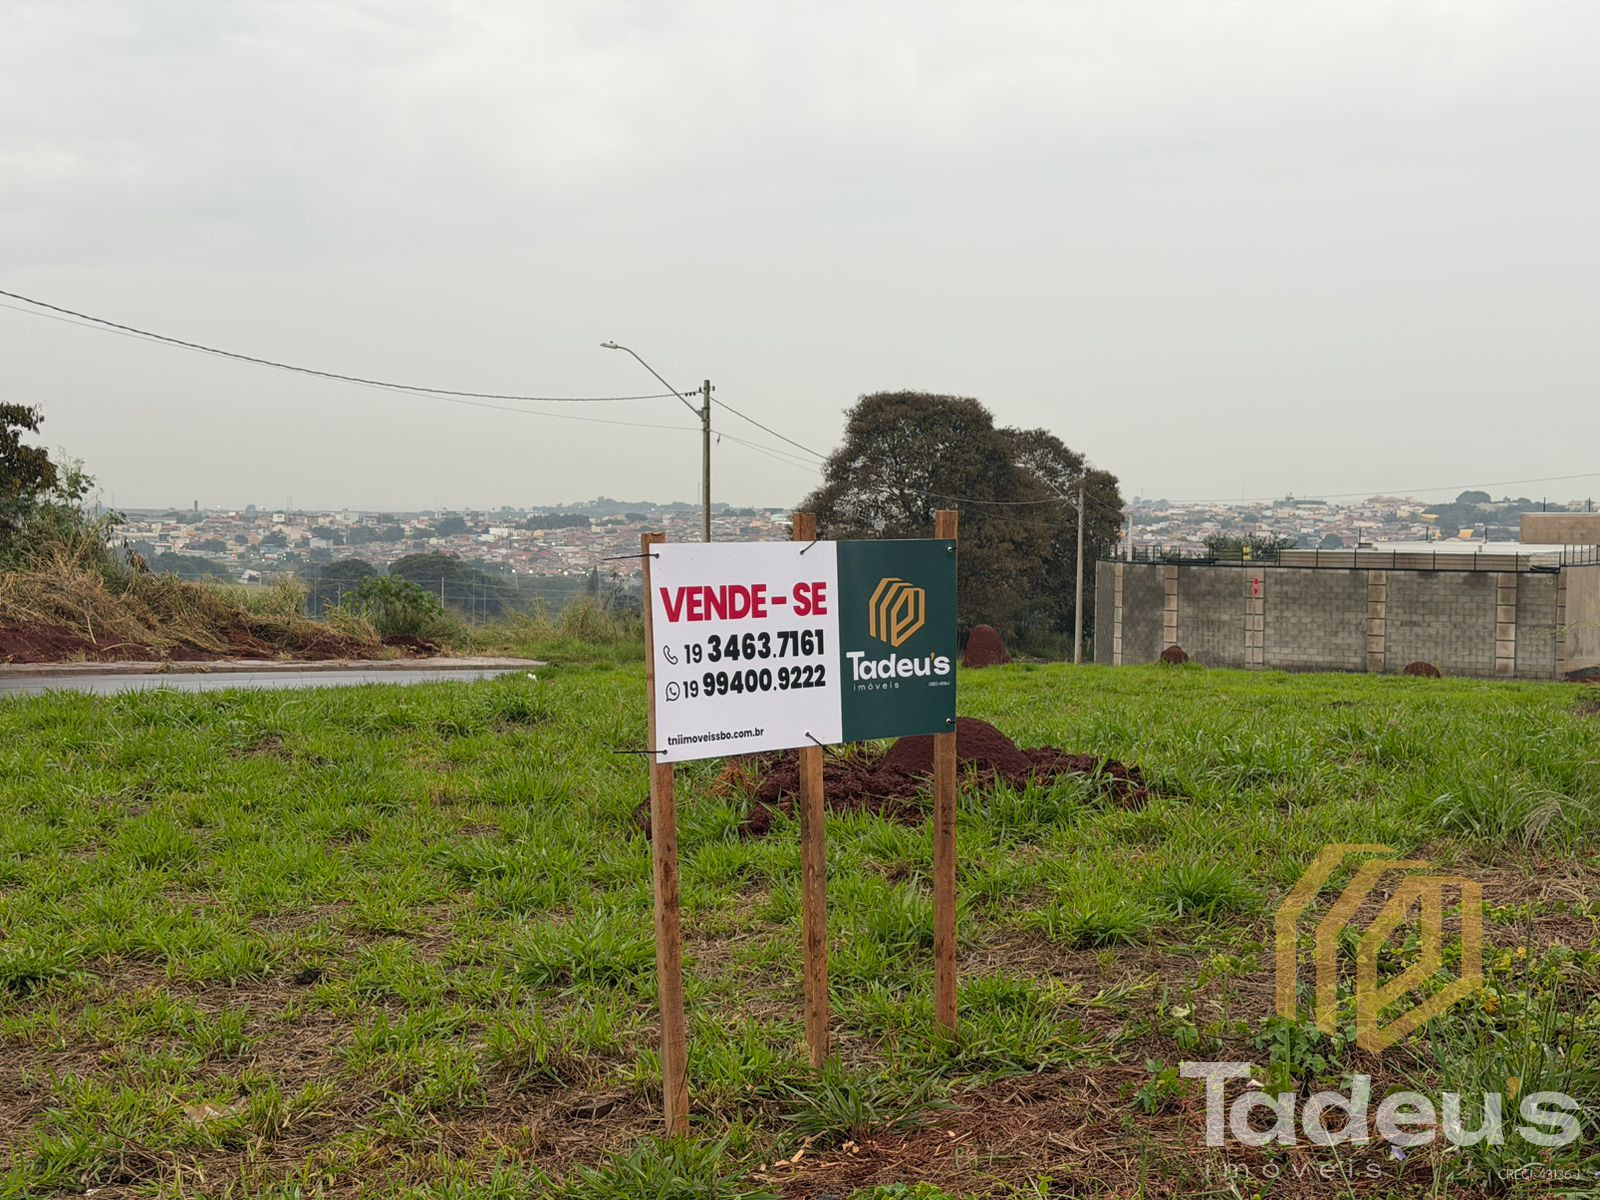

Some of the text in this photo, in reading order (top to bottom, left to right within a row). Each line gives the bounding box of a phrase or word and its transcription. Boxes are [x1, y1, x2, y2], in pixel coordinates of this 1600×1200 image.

[684, 629, 825, 664] 19 3463.7161
[683, 664, 826, 698] 19 99400.9222
[846, 651, 951, 681] Tadeu's
[853, 682, 900, 691] imóveis
[667, 727, 764, 746] tniimoveissbo.com.br
